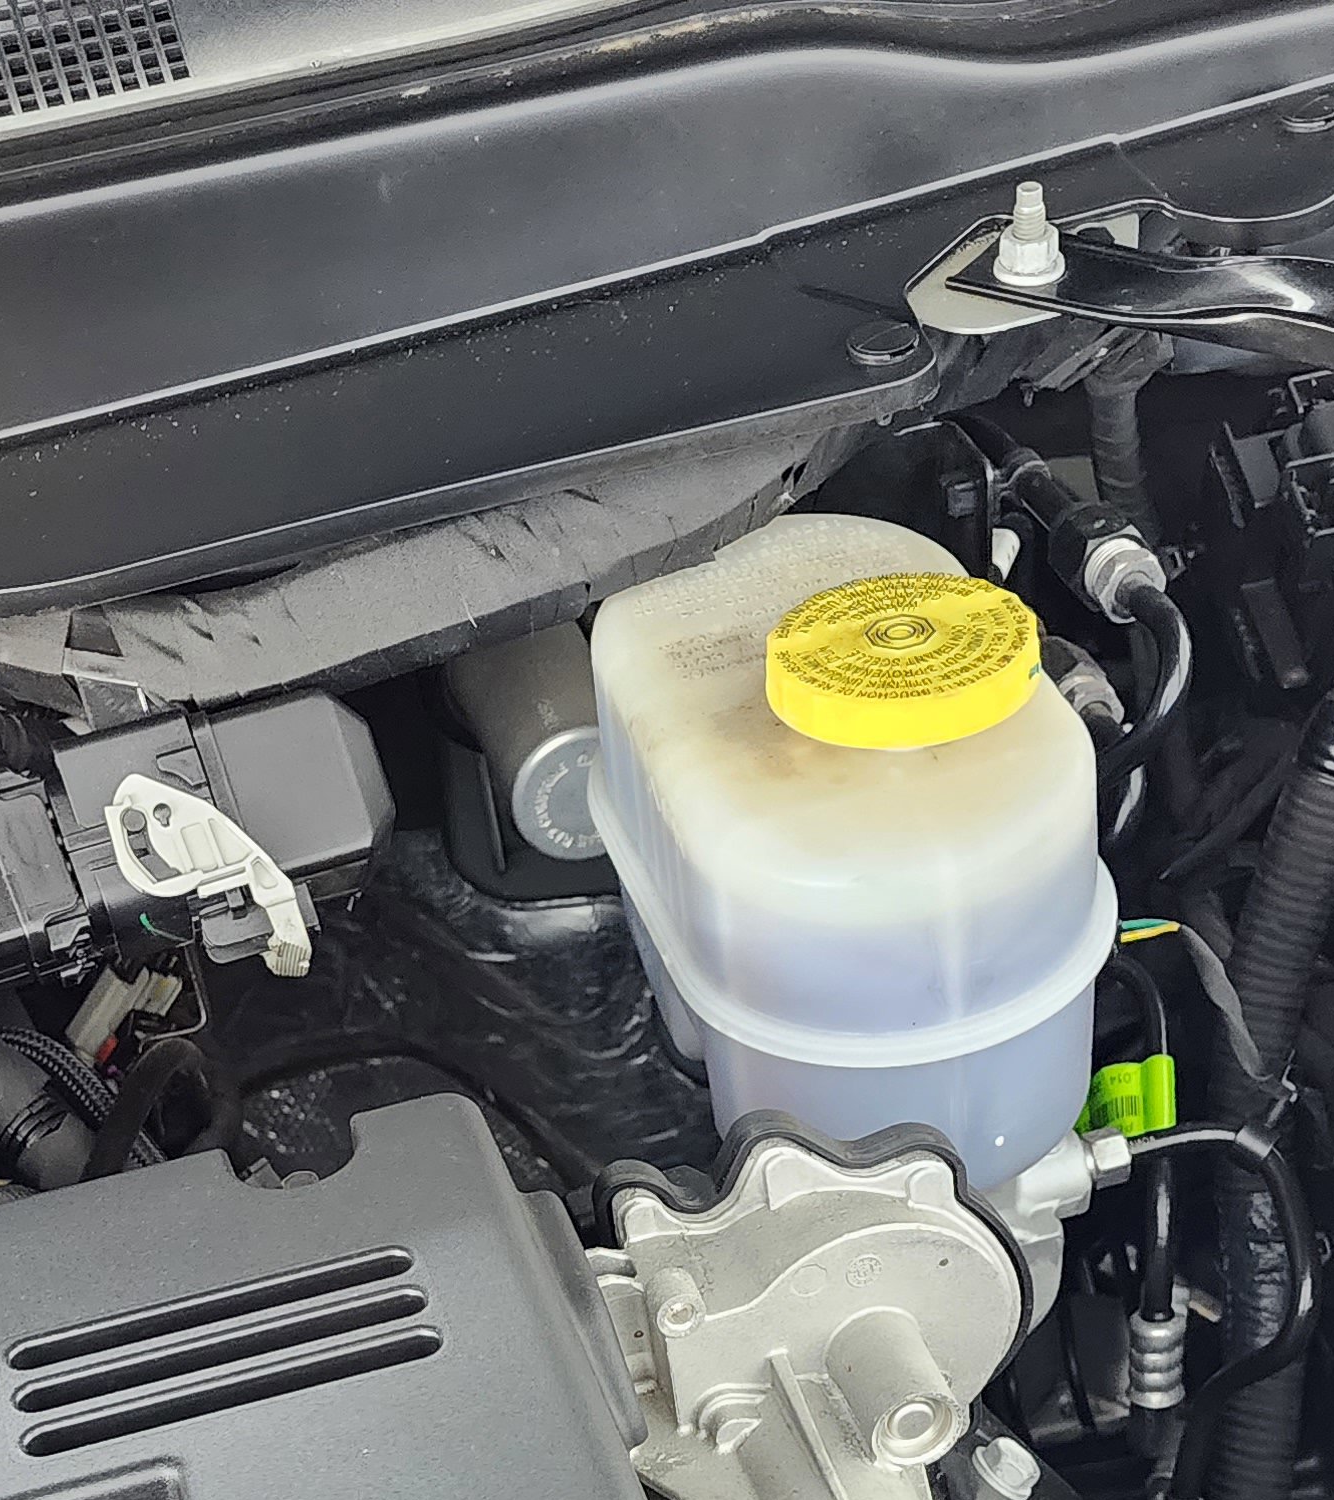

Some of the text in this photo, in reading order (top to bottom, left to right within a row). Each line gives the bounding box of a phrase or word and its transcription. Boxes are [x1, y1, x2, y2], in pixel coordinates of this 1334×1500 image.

[875, 570, 917, 581] FROM
[921, 568, 963, 583] FLUID
[807, 578, 864, 601] SEALED
[918, 579, 975, 599] BEFORE
[775, 596, 820, 638] CONTAINER
[795, 613, 822, 633] ONLY
[980, 605, 1012, 630] AVANT
[903, 623, 971, 669] CONTENANT
[958, 622, 988, 656] LIQUIDE
[769, 649, 840, 691] REMPLISSAGE
[789, 649, 867, 688] UNIQUEMENT
[832, 658, 930, 680] PROVENANT
[948, 652, 1019, 690] NETTOYER
[853, 686, 935, 701] BOUCHON
[863, 676, 936, 690] UTILISER
